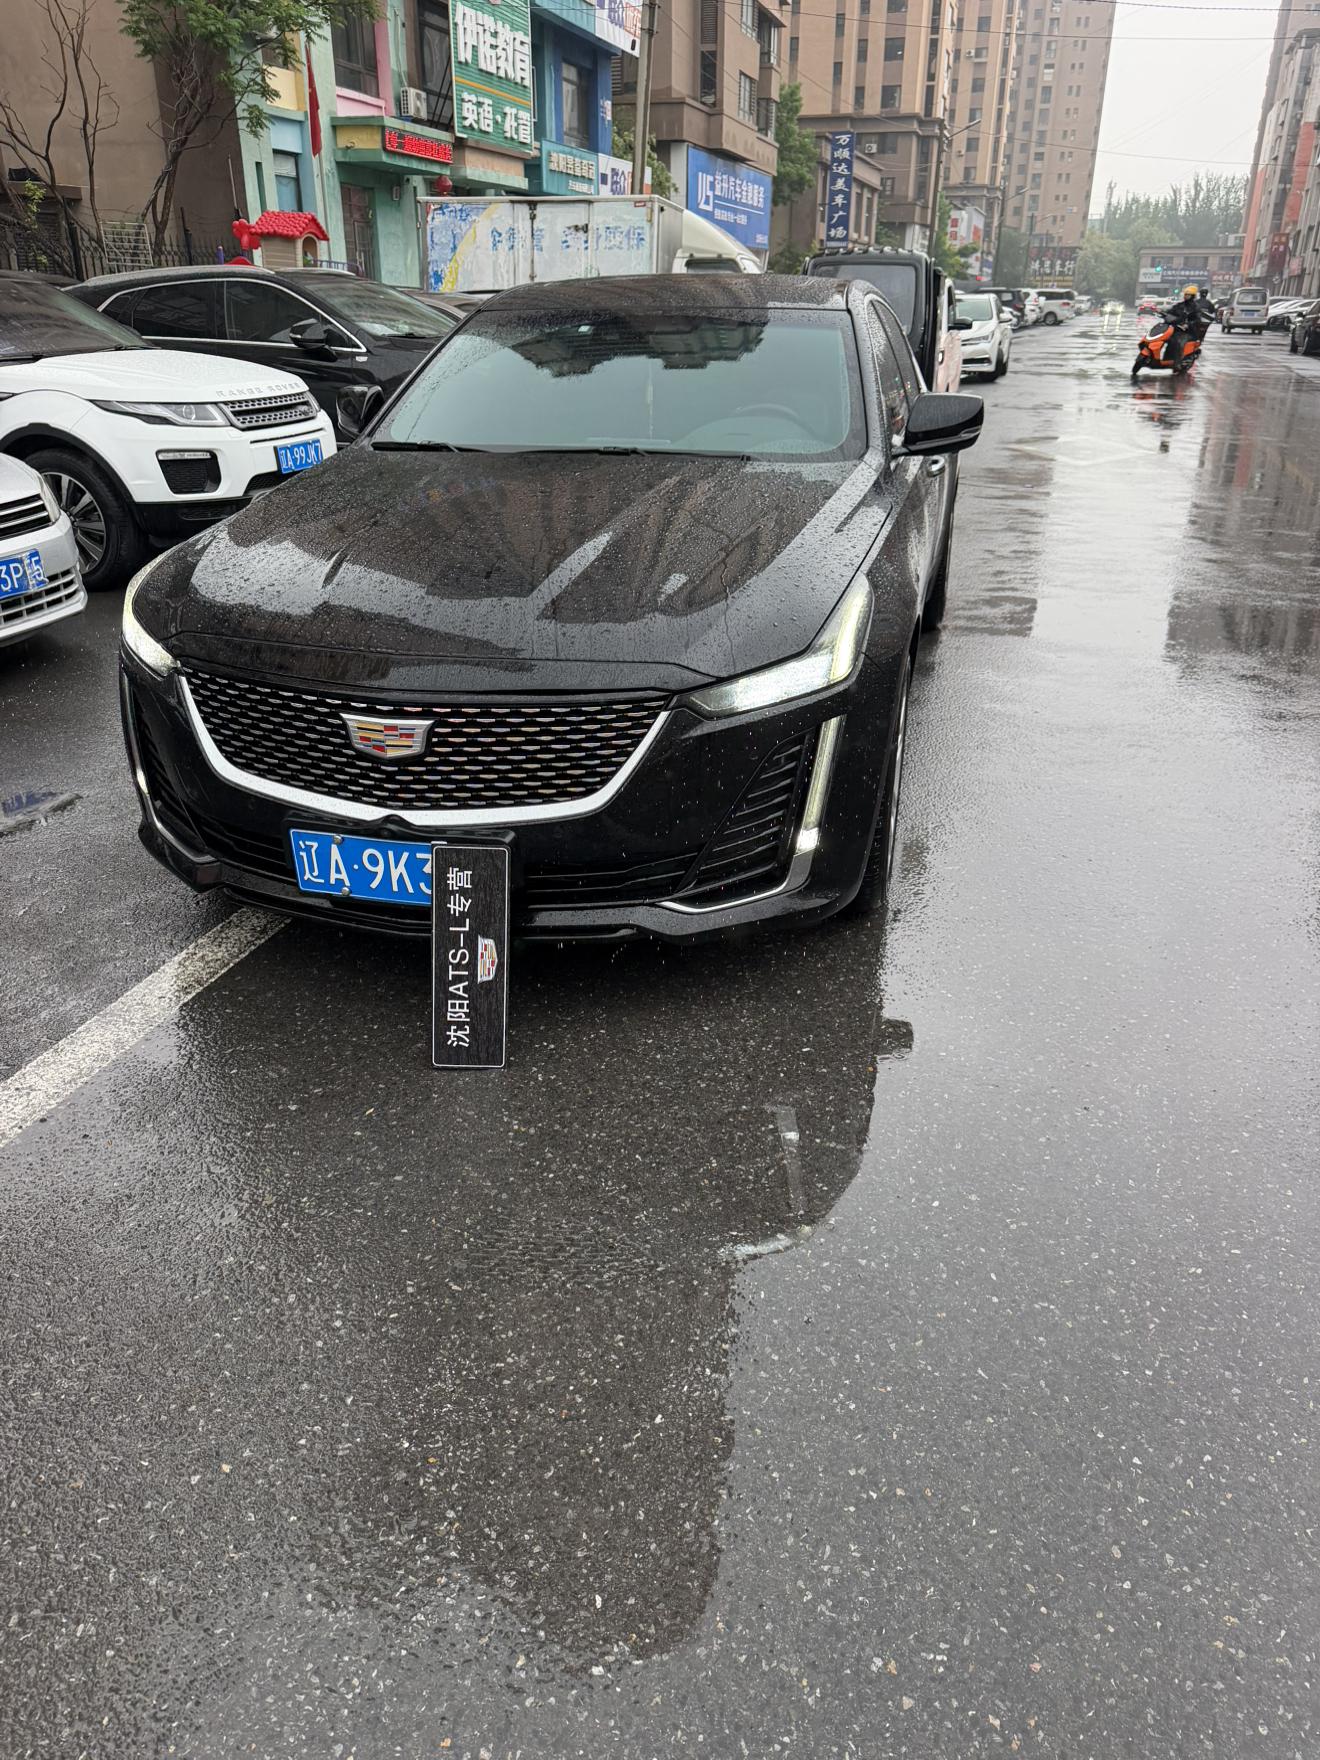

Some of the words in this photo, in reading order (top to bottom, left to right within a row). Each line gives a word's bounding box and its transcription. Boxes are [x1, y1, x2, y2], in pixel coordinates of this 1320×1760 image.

[455, 1, 530, 88] 伊诺教育
[828, 134, 852, 239] 万顺达美车广场
[446, 867, 473, 1047] 沈阳ATS-L专营
